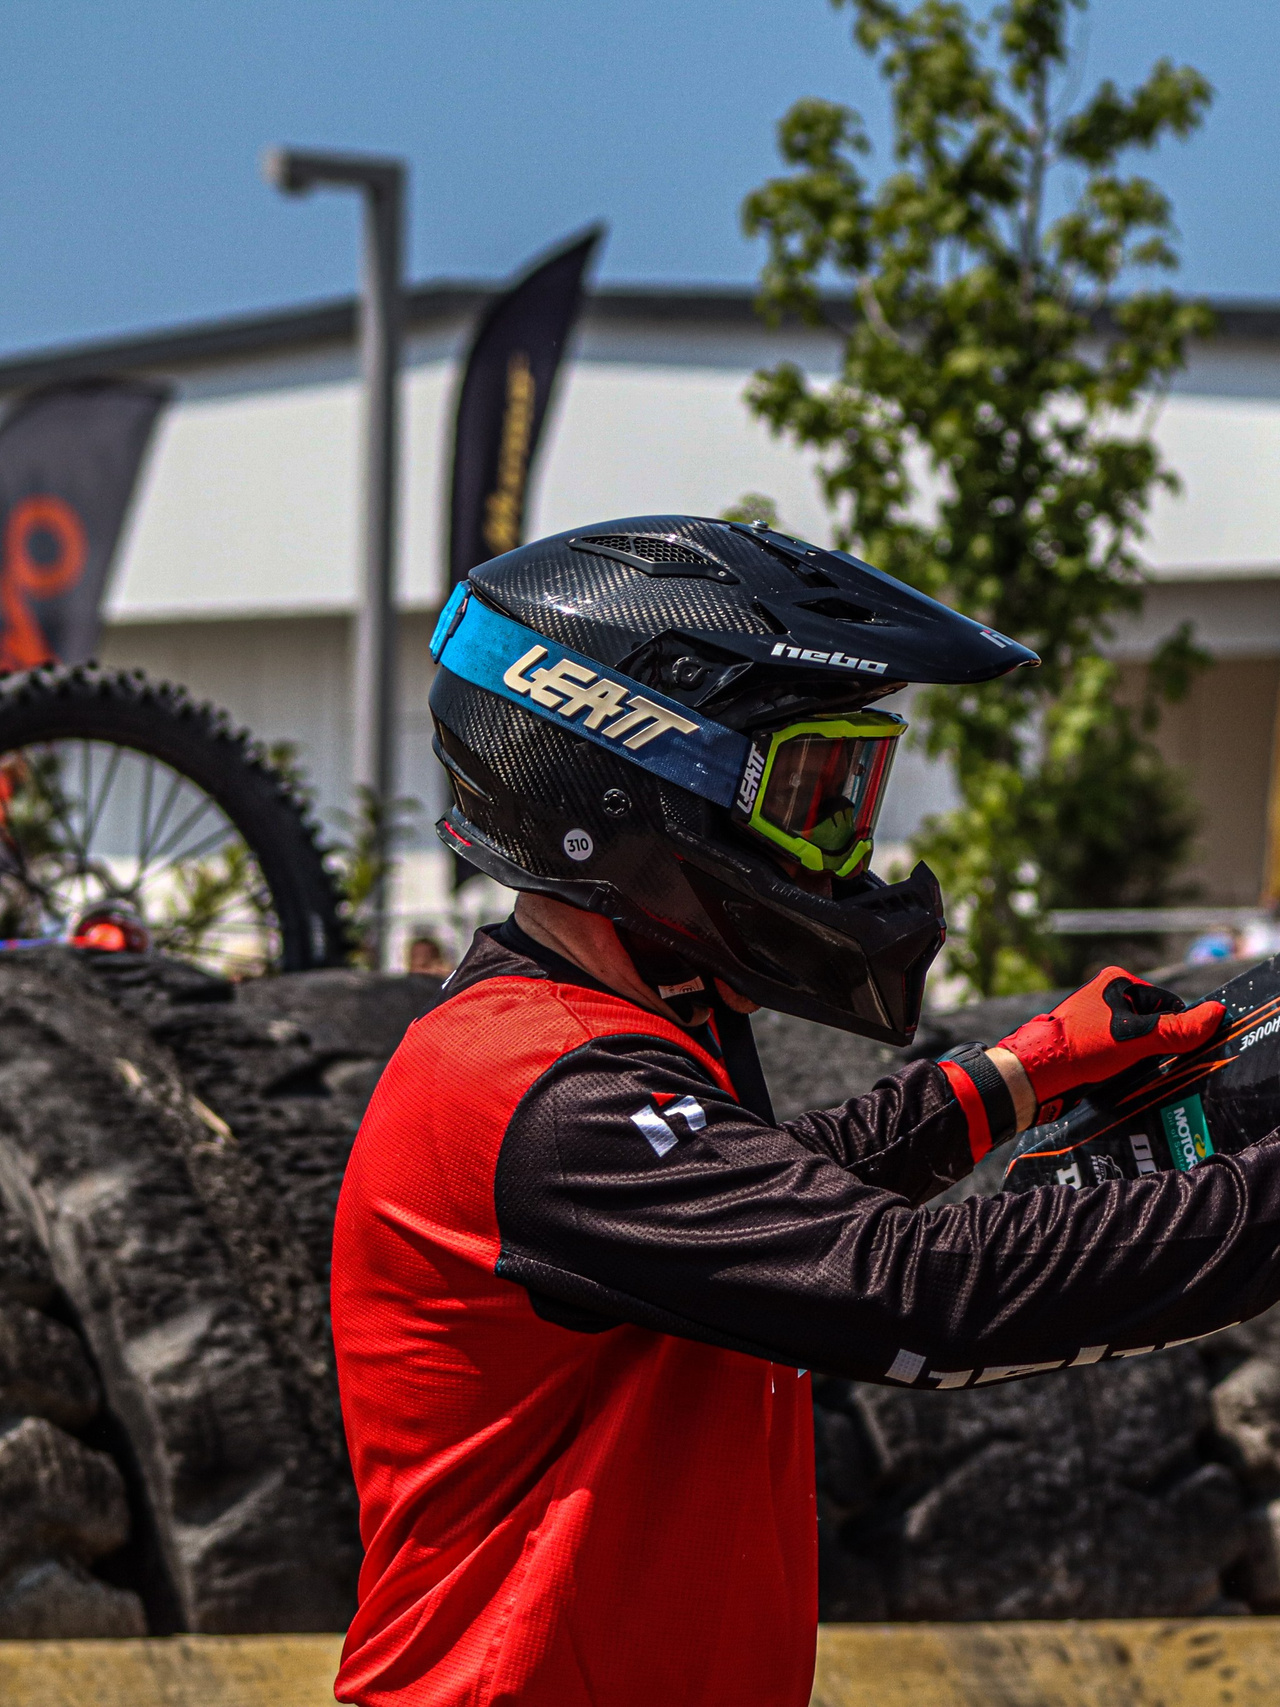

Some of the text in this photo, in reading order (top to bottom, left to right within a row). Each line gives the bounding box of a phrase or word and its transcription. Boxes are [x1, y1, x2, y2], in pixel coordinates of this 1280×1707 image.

[503, 644, 700, 752] LEATT
[736, 743, 768, 815] LEATT
[566, 837, 590, 853] 310
[1173, 1106, 1198, 1170] MOTOR
[1174, 1141, 1187, 1172] Switze
